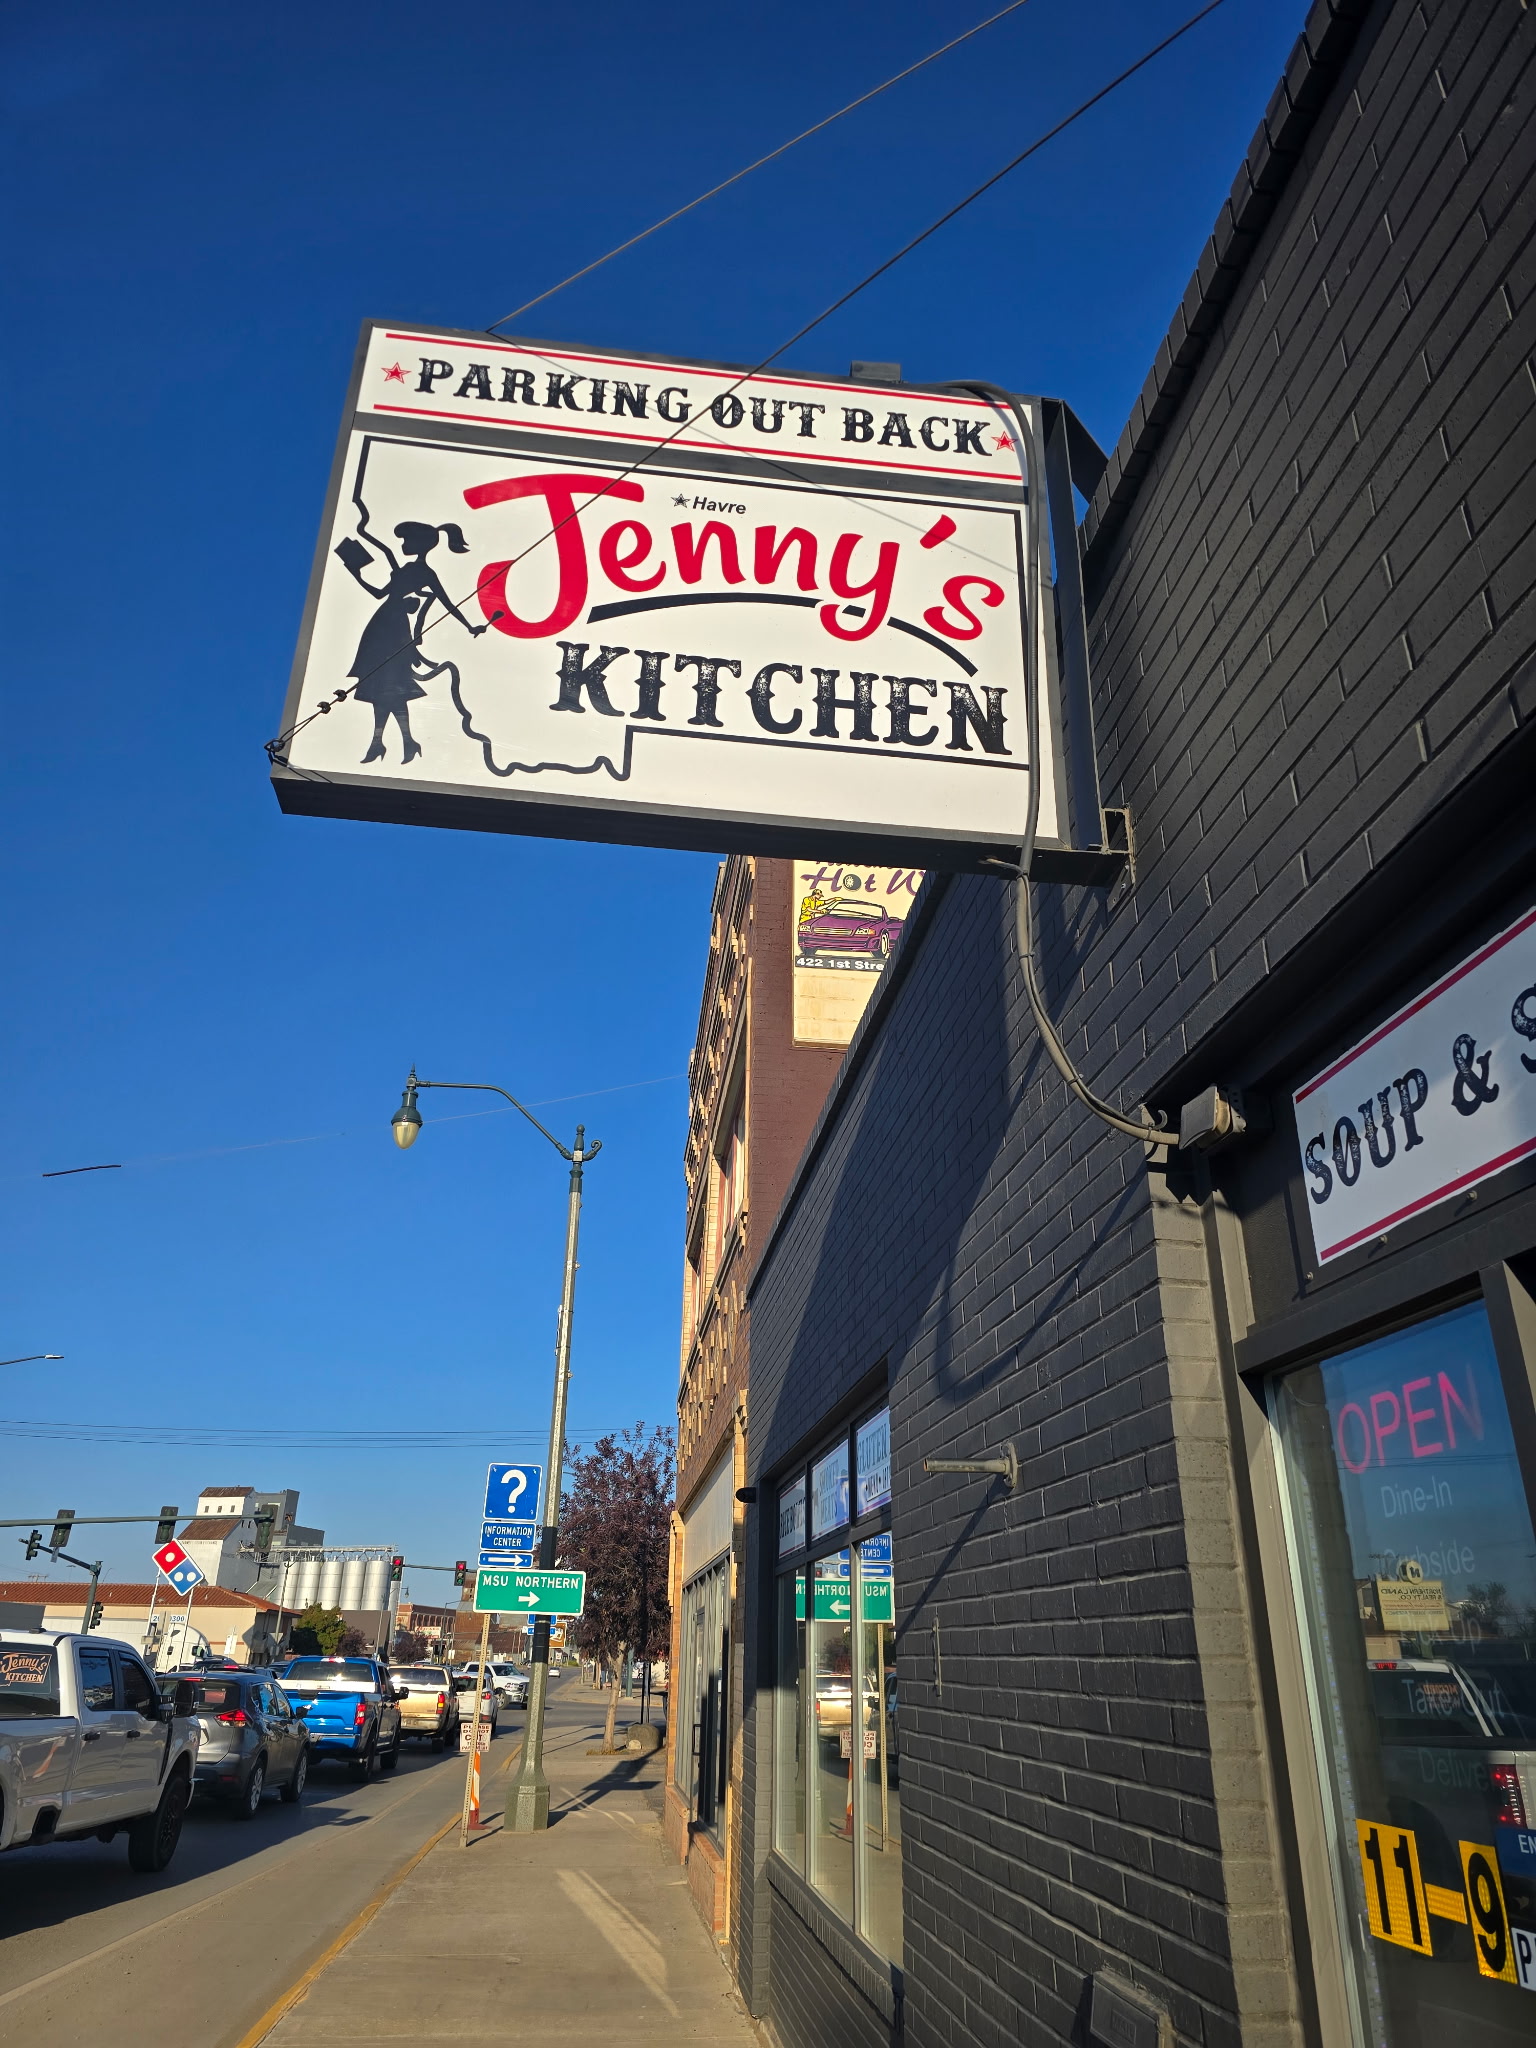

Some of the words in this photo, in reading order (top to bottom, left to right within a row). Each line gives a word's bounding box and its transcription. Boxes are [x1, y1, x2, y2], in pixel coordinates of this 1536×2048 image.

[414, 356, 692, 424] PARKING
[711, 393, 828, 439] OUT
[840, 405, 993, 457] BACK
[692, 496, 747, 515] Havre
[463, 473, 1006, 643] Jenny's
[550, 641, 1012, 756] KITCHEN
[796, 957, 824, 967] 422
[827, 959, 851, 969] 1st
[1305, 1068, 1428, 1205] SOUP
[1451, 1033, 1499, 1116] &
[1337, 1364, 1484, 1475] OPEN
[1381, 1475, 1453, 1518] Dine-In
[484, 1526, 533, 1537] INFORMATION
[493, 1537, 522, 1547] CENTER
[482, 1575, 509, 1586] MSU
[515, 1576, 580, 1589] NORTHERN
[1, 1654, 47, 1673] Jenny's
[5, 1673, 44, 1682] KITCHEN
[1516, 1932, 1536, 1984] P
